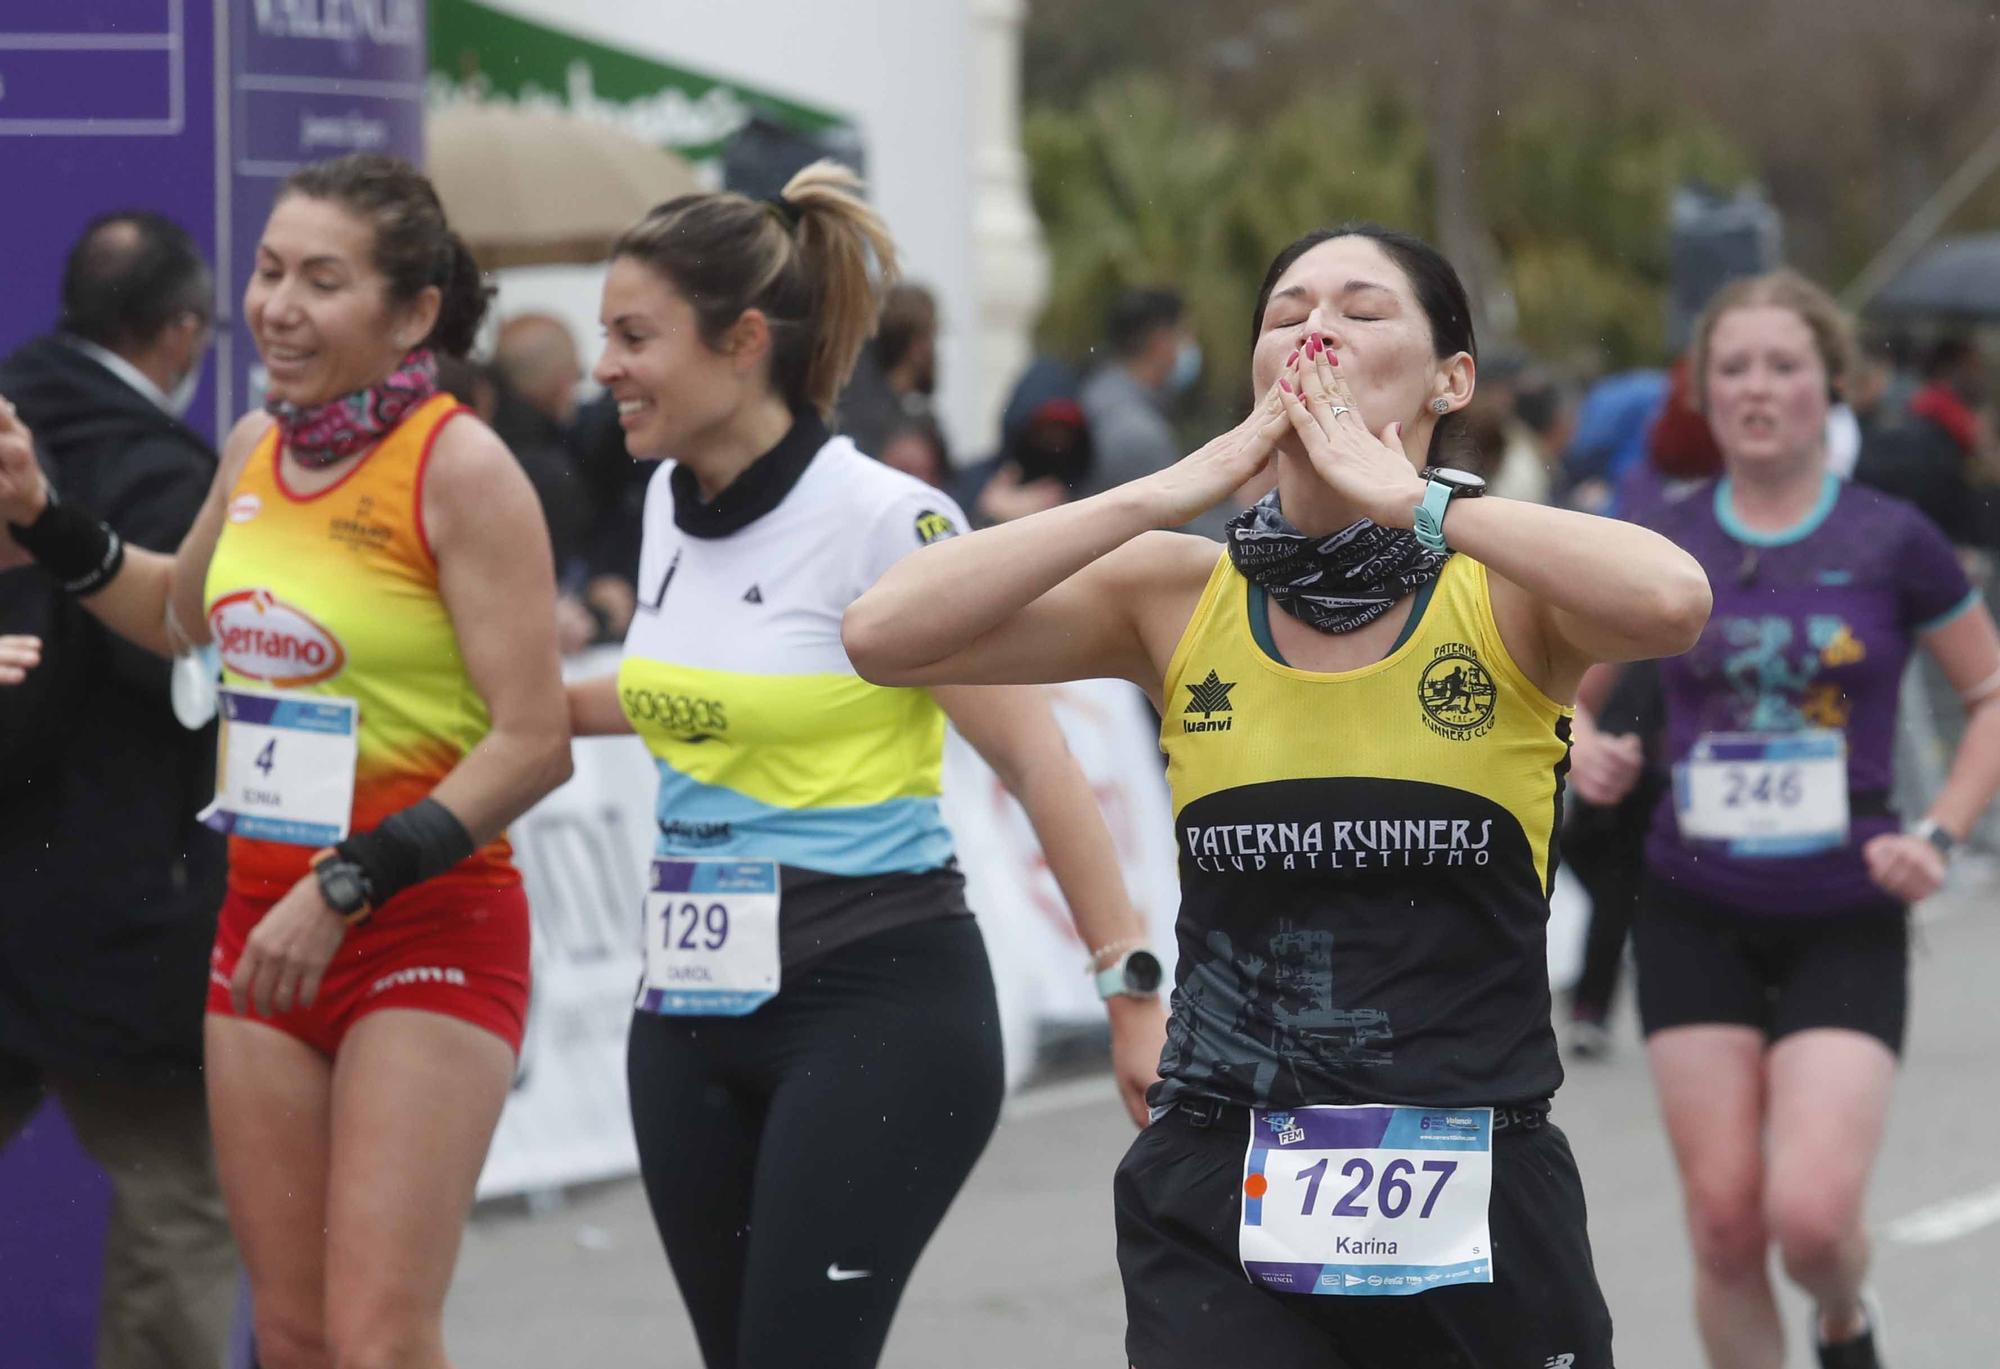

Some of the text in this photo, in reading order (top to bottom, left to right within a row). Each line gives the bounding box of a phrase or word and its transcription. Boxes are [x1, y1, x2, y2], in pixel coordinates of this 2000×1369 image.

[1433, 642, 1478, 660] PATERNA
[1183, 716, 1233, 734] luanvi
[1421, 713, 1472, 742] RUNNERS
[254, 737, 277, 778] 4
[1723, 770, 1803, 808] 246
[1186, 819, 1493, 856] PATERNA RUNNERS
[1196, 850, 1490, 873] CLUB ATLETISMO
[660, 902, 729, 951] 129
[1281, 1130, 1303, 1144] FEM
[1295, 1157, 1459, 1219] 1267
[1336, 1236, 1398, 1255] Karina
